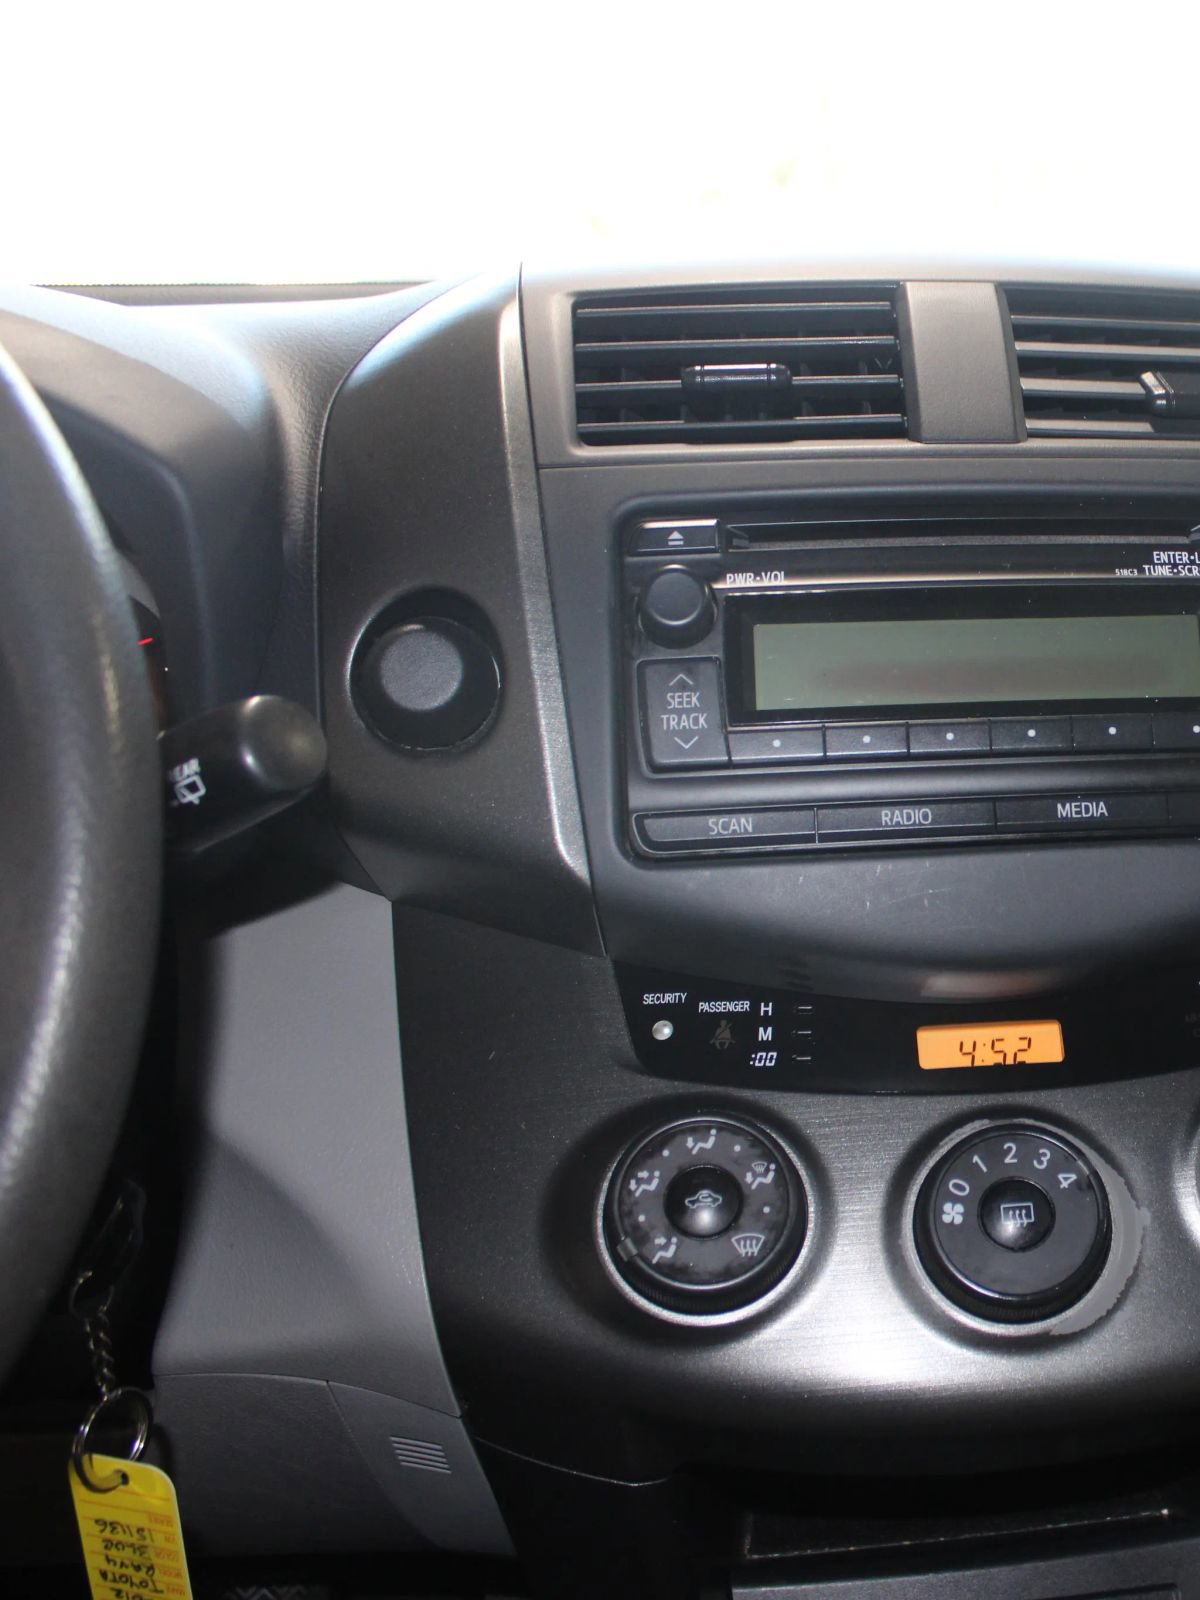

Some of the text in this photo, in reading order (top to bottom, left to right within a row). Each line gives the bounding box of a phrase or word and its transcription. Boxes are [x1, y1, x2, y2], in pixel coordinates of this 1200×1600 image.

[666, 692, 700, 709] SEEK
[661, 713, 708, 730] TRACK
[881, 808, 932, 826] RADIO
[1057, 801, 1108, 819] MEDIA
[708, 817, 753, 835] SCAN
[643, 992, 687, 1005] SECURITY
[698, 1001, 750, 1013] PASSENGER
[760, 1002, 773, 1016] H
[758, 1027, 773, 1041] M
[959, 1036, 1032, 1067] 4:52
[1003, 1142, 1018, 1164] 2
[1033, 1149, 1051, 1169] 3
[972, 1154, 988, 1173] 1
[1057, 1173, 1077, 1189] 4
[99, 1568, 164, 1593] TOYOTA
